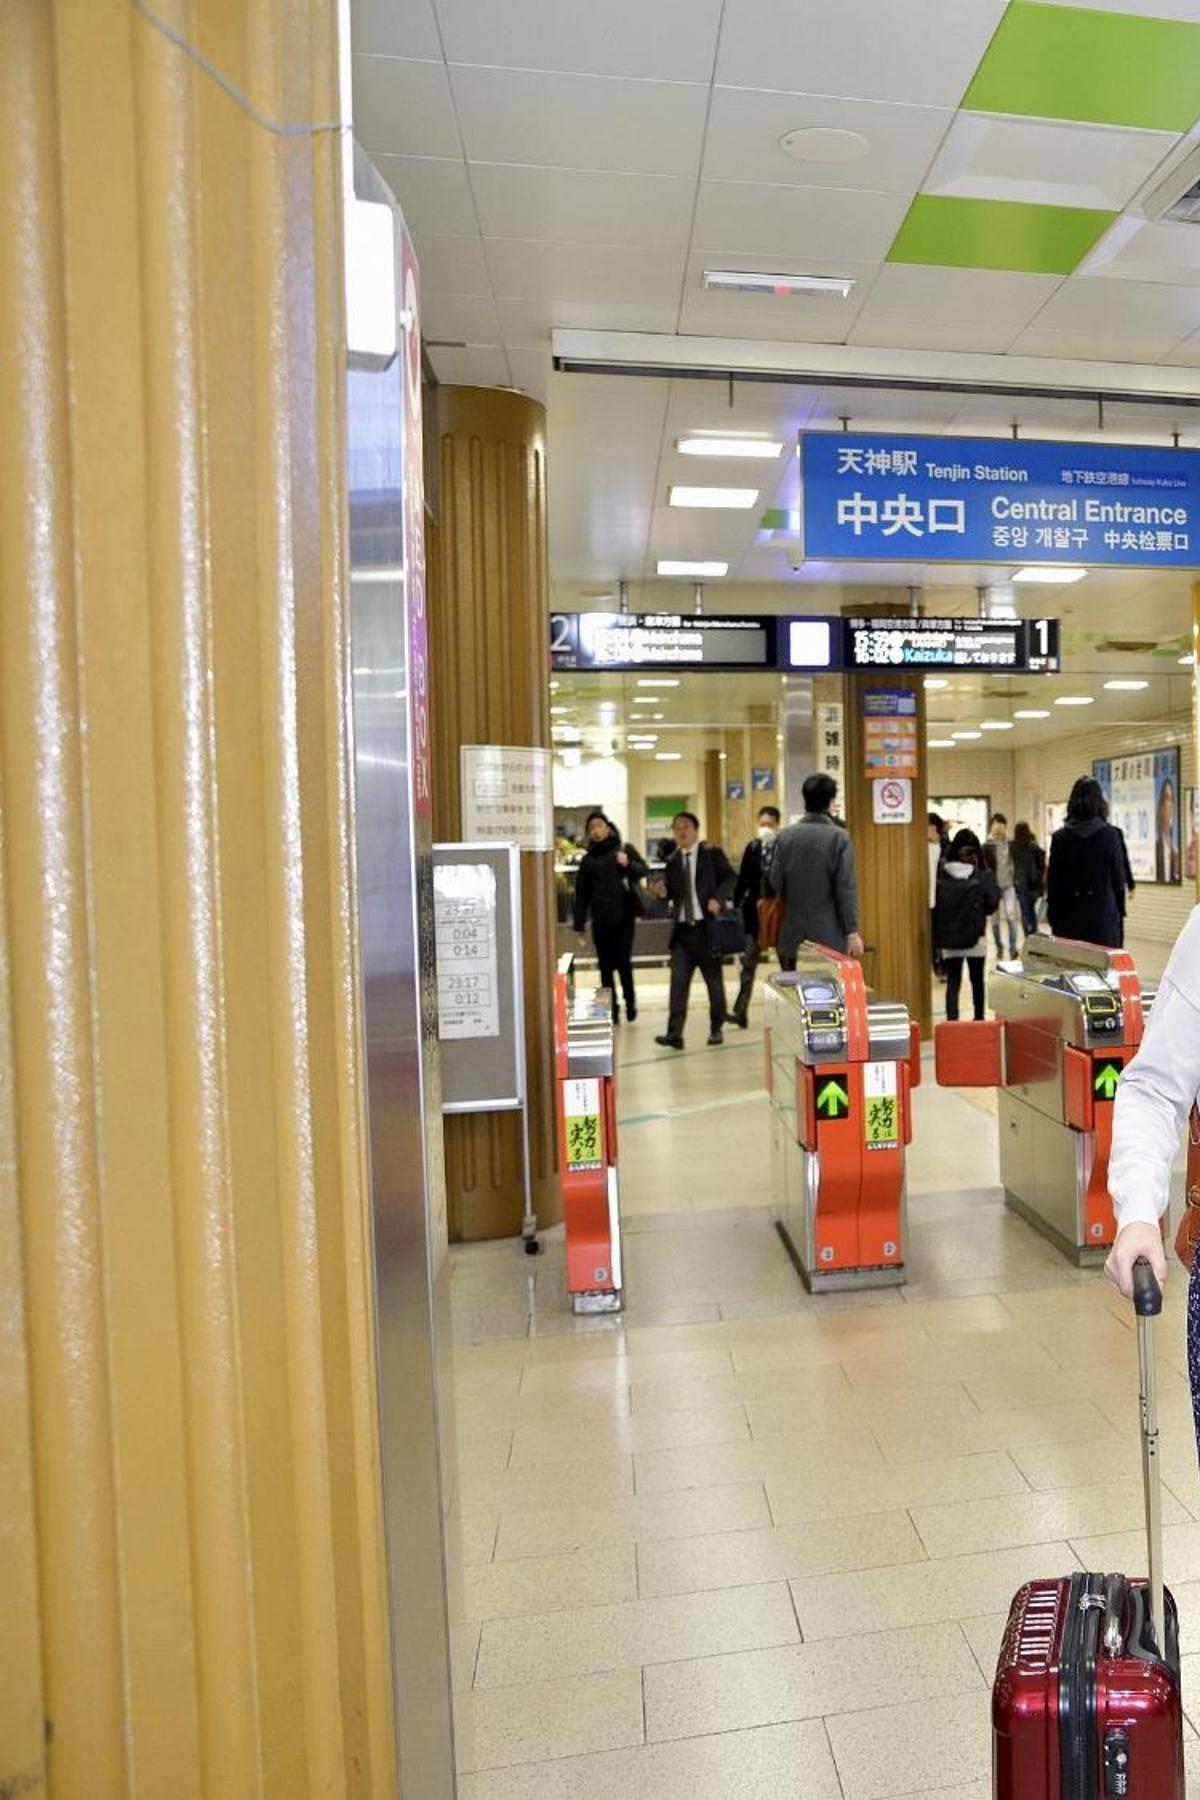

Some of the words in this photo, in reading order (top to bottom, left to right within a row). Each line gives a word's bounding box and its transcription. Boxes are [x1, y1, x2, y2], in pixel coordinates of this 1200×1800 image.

[837, 448, 918, 476] 天神駅
[925, 463, 971, 481] Tenjin
[974, 464, 1028, 483] Station
[837, 492, 966, 536] 中央口
[992, 497, 1077, 522] Central
[1085, 500, 1187, 525] Entrance
[992, 526, 1029, 549] 중앙
[1036, 527, 1089, 550] 개찰구
[550, 616, 572, 651] 2
[1034, 620, 1049, 655] 1
